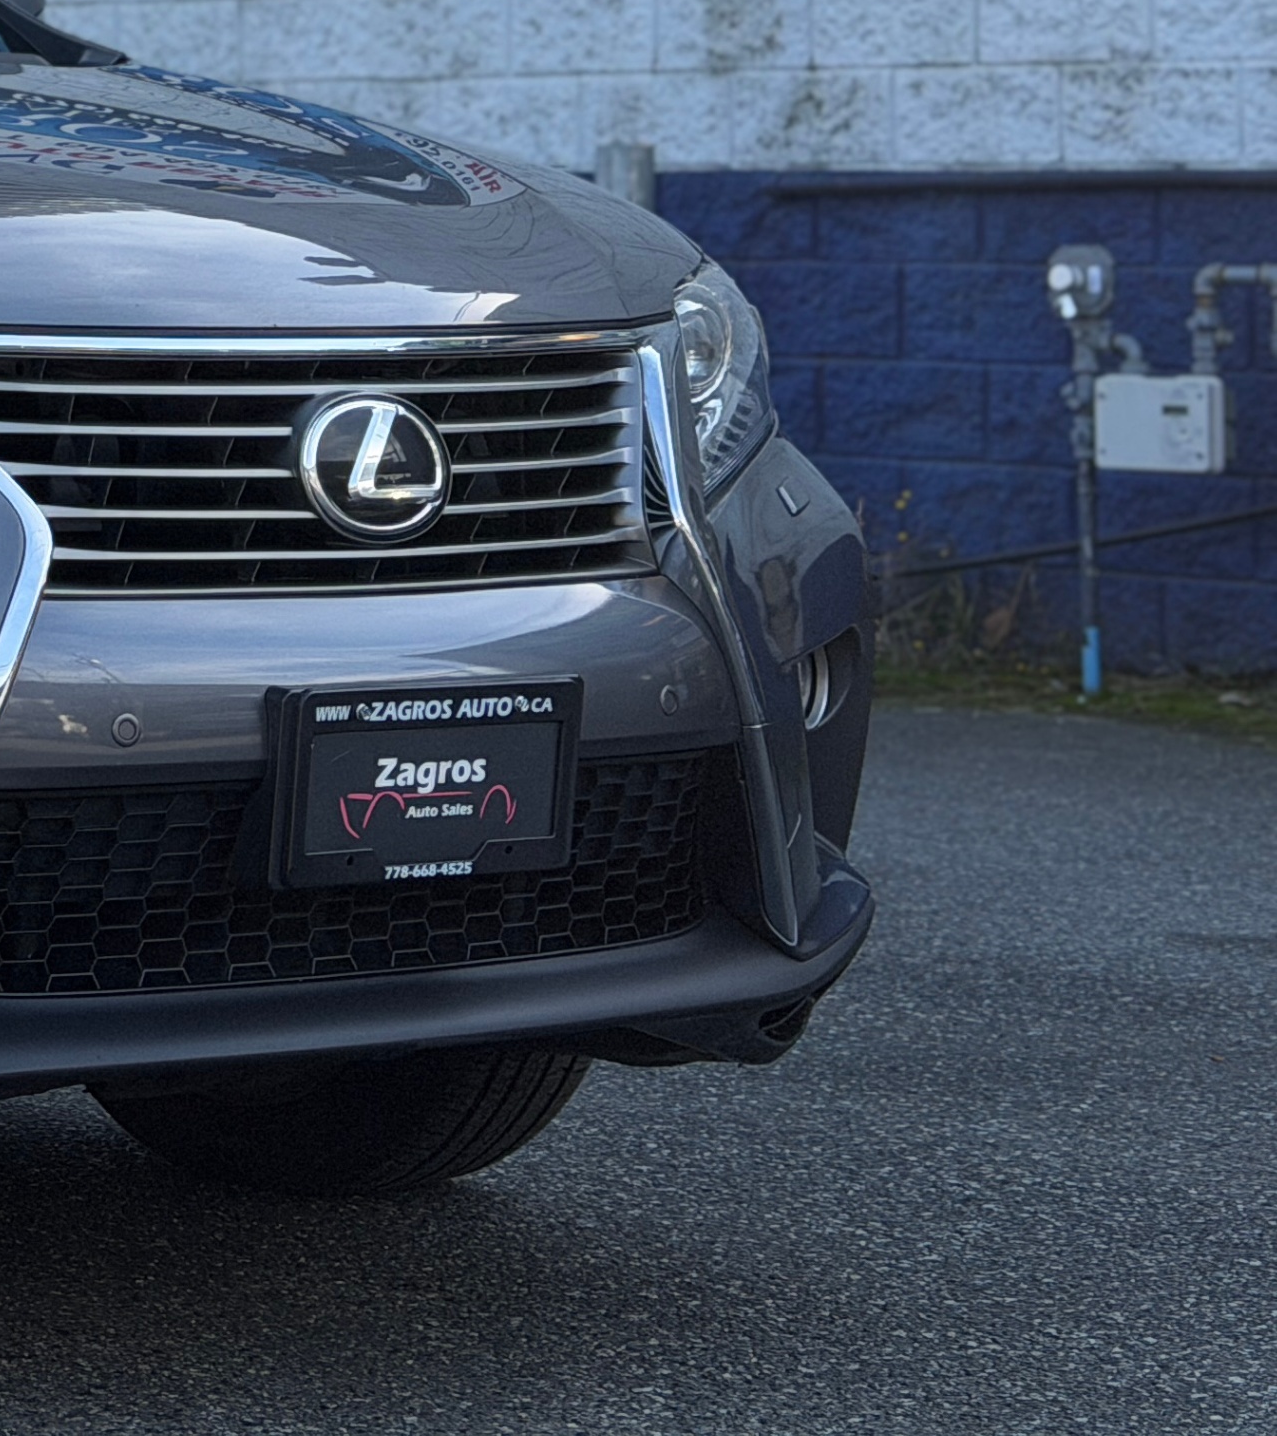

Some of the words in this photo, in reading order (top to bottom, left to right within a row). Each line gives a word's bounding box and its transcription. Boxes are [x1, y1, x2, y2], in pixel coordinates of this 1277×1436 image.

[369, 699, 453, 722] ZAGROS
[456, 696, 512, 719] AUTO
[530, 697, 554, 713] CA
[375, 757, 488, 795] Zagros
[404, 804, 439, 820] Auto
[441, 802, 474, 817] Sales
[384, 860, 474, 880] 778-668-4525
